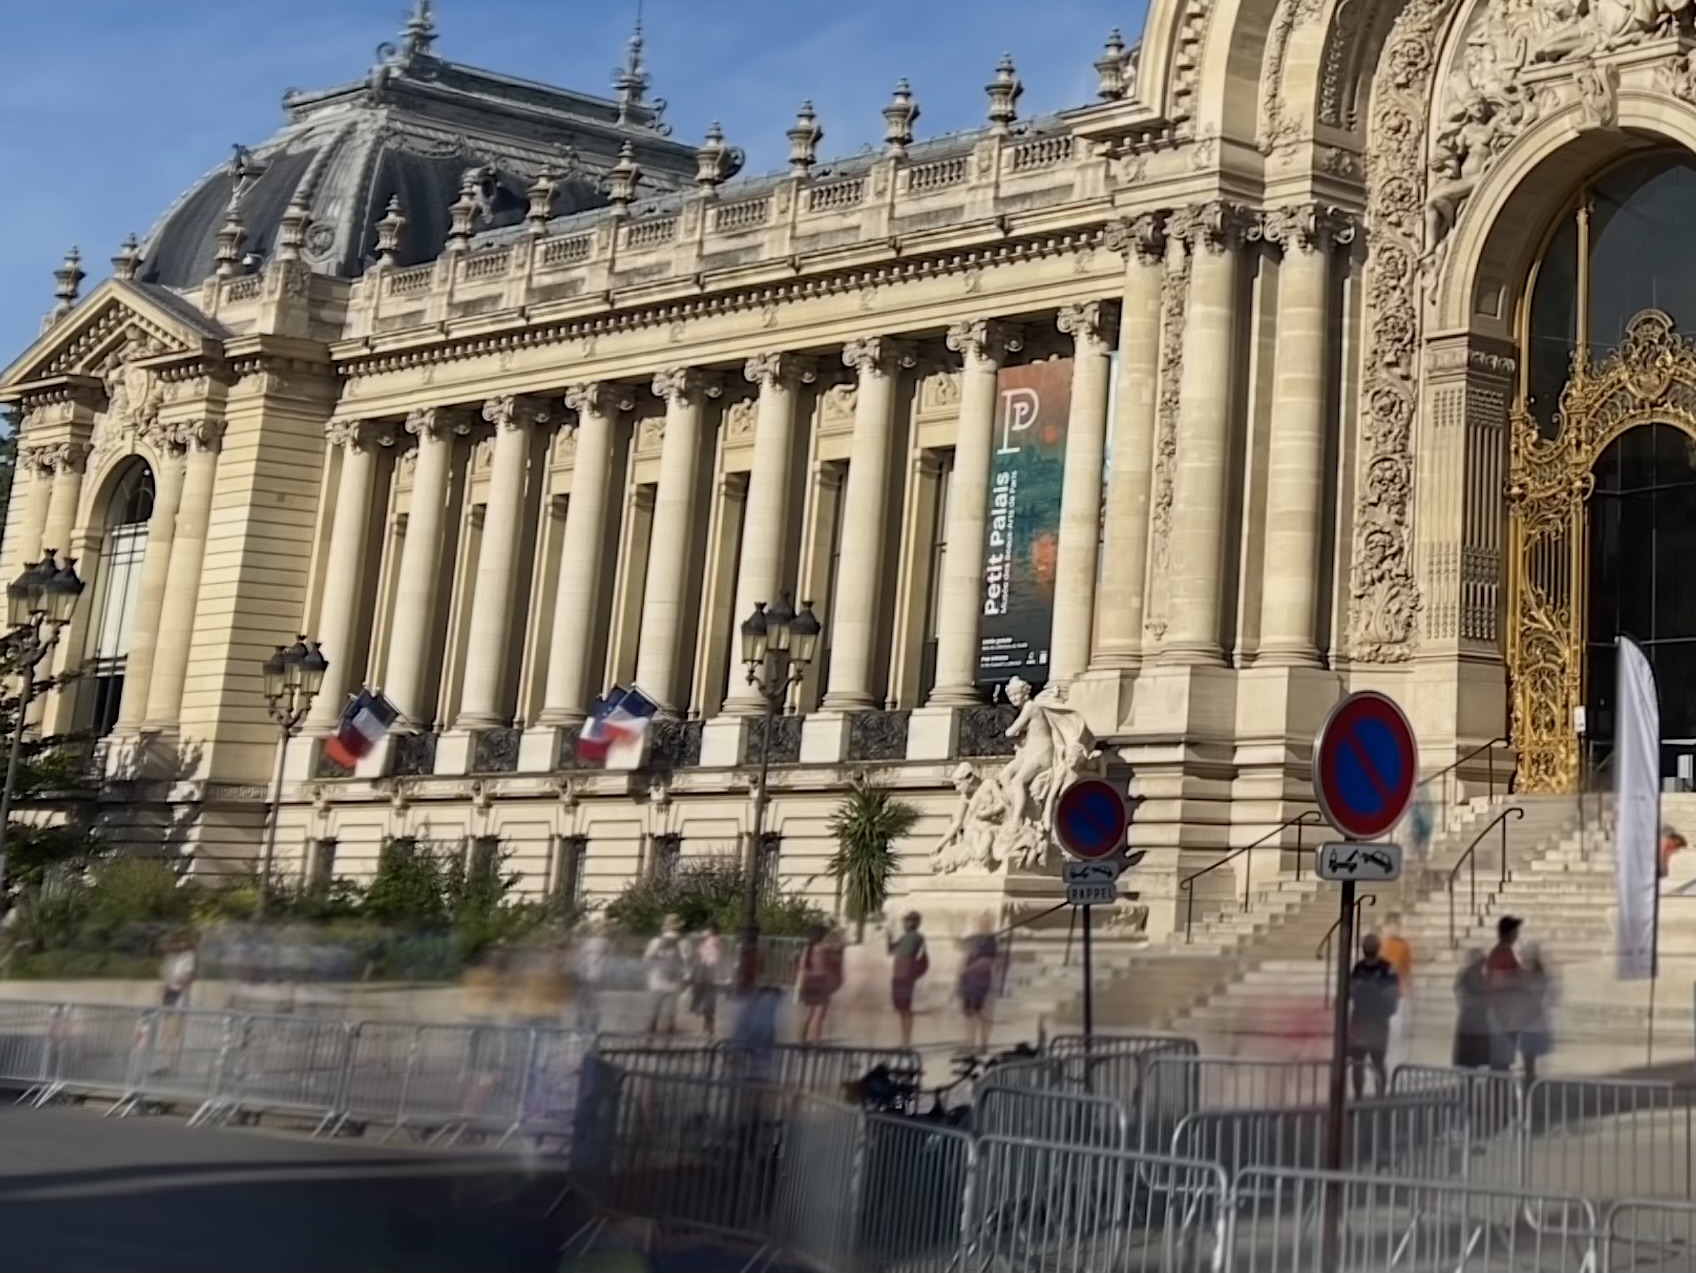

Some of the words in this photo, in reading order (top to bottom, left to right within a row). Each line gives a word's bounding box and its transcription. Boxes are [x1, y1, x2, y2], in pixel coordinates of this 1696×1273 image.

[990, 471, 1011, 547] Palais
[984, 553, 1004, 616] Petit
[1071, 888, 1112, 899] RAPPEL
